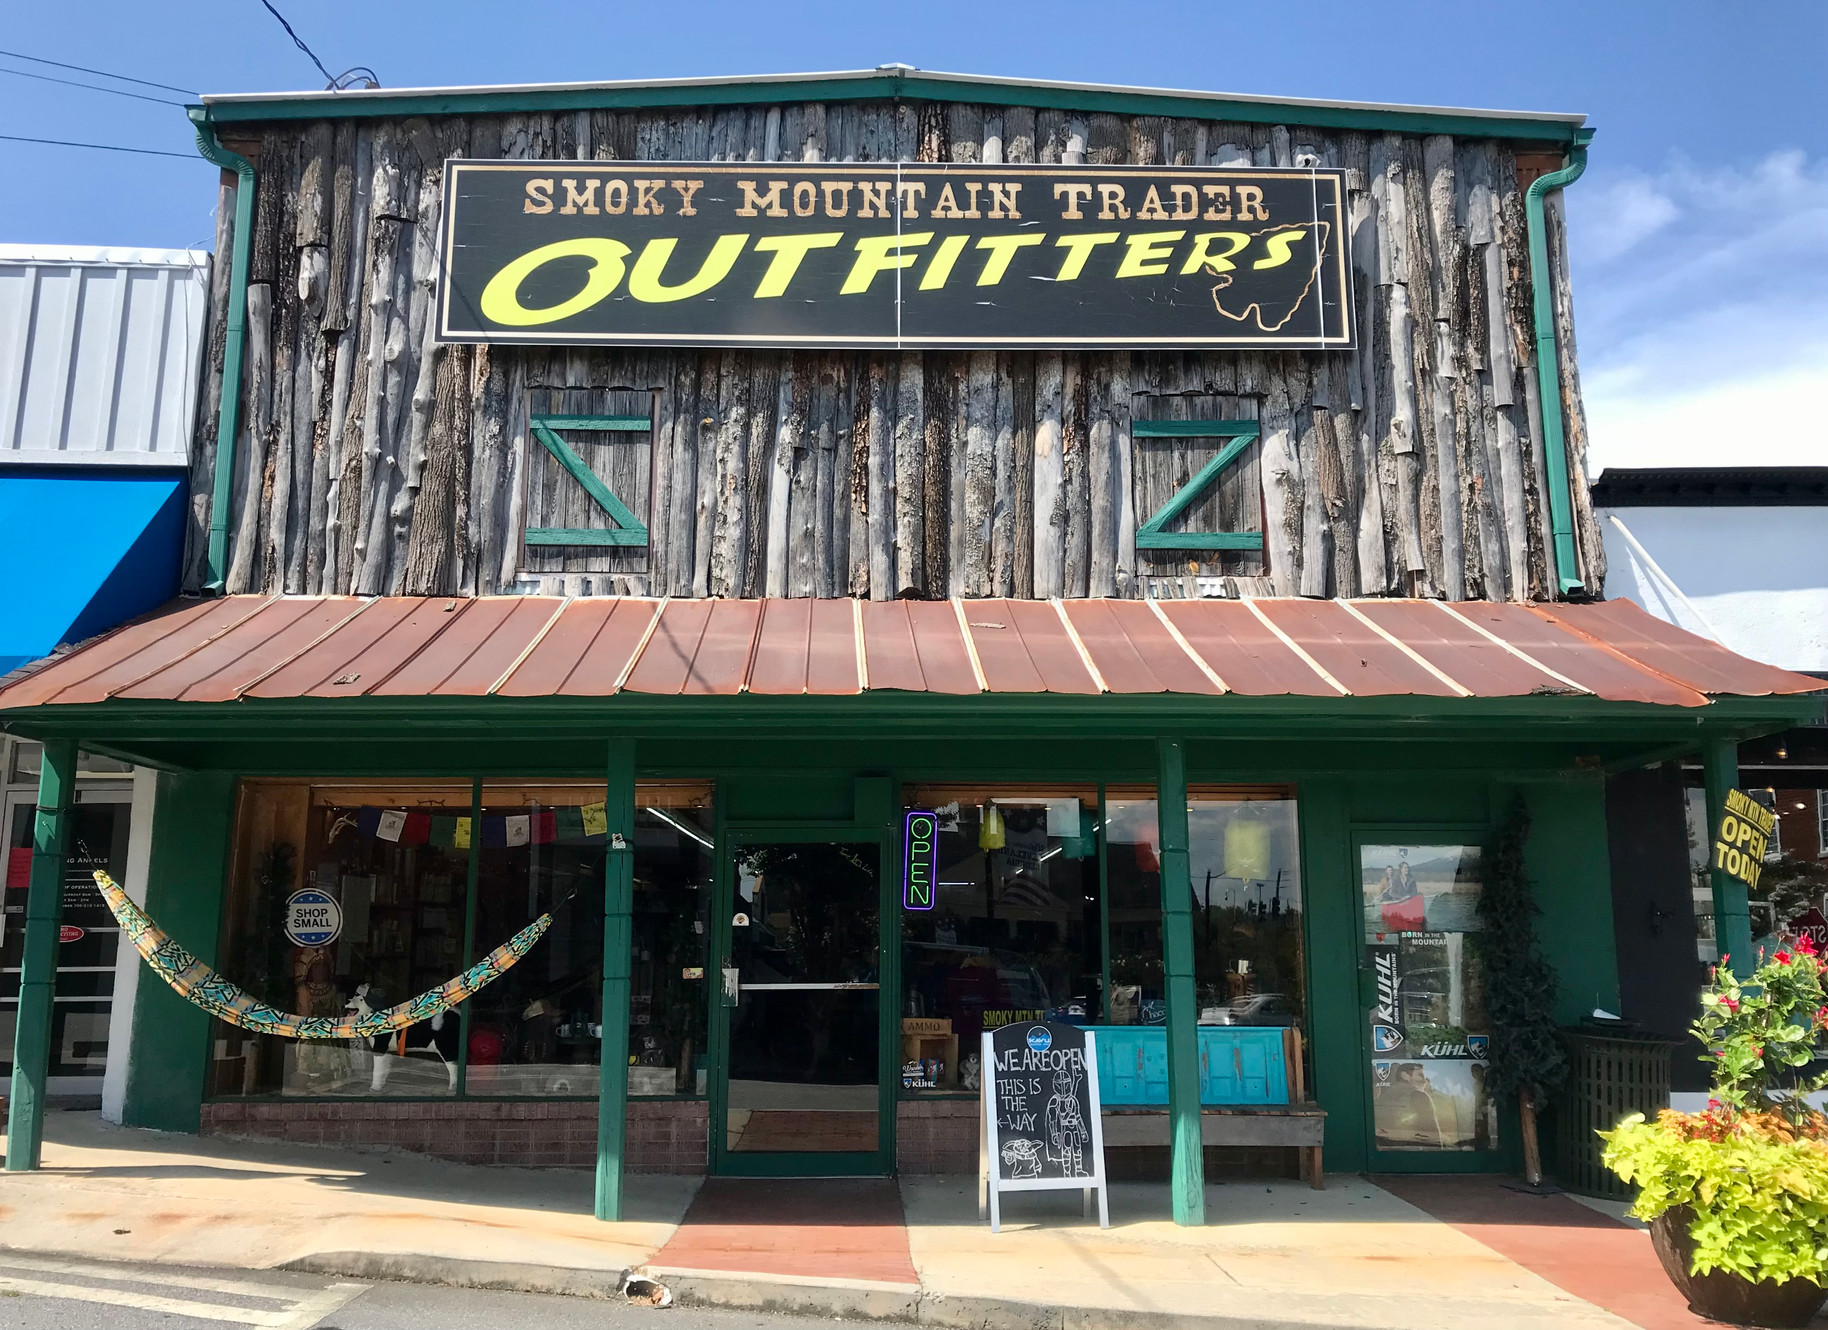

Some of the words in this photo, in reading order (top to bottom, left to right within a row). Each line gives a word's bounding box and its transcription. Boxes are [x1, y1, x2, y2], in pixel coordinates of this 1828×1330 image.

[523, 178, 704, 218] SMOKY
[735, 181, 1022, 220] MOUNTAIN
[1053, 182, 1270, 221] TRADER
[480, 230, 1307, 326] OUTFITTERS
[1721, 815, 1768, 864] OPEN
[911, 817, 932, 904] OPEN
[1716, 841, 1762, 890] TODAY
[296, 908, 328, 919] SHOP
[293, 918, 333, 929] SMALL
[1411, 938, 1448, 946] MOUNTAI
[983, 1009, 1013, 1026] SMOKY
[1015, 1009, 1033, 1022] MTN
[908, 1022, 941, 1032] AMMO
[1420, 1041, 1468, 1058] KÜHL
[993, 1048, 1019, 1072] WE
[1021, 1048, 1051, 1072] ARE
[1050, 1048, 1088, 1071] OPEN
[996, 1078, 1026, 1095] THIS
[1028, 1078, 1042, 1095] IS
[1001, 1096, 1028, 1112] THE
[1006, 1112, 1038, 1131] WAY
